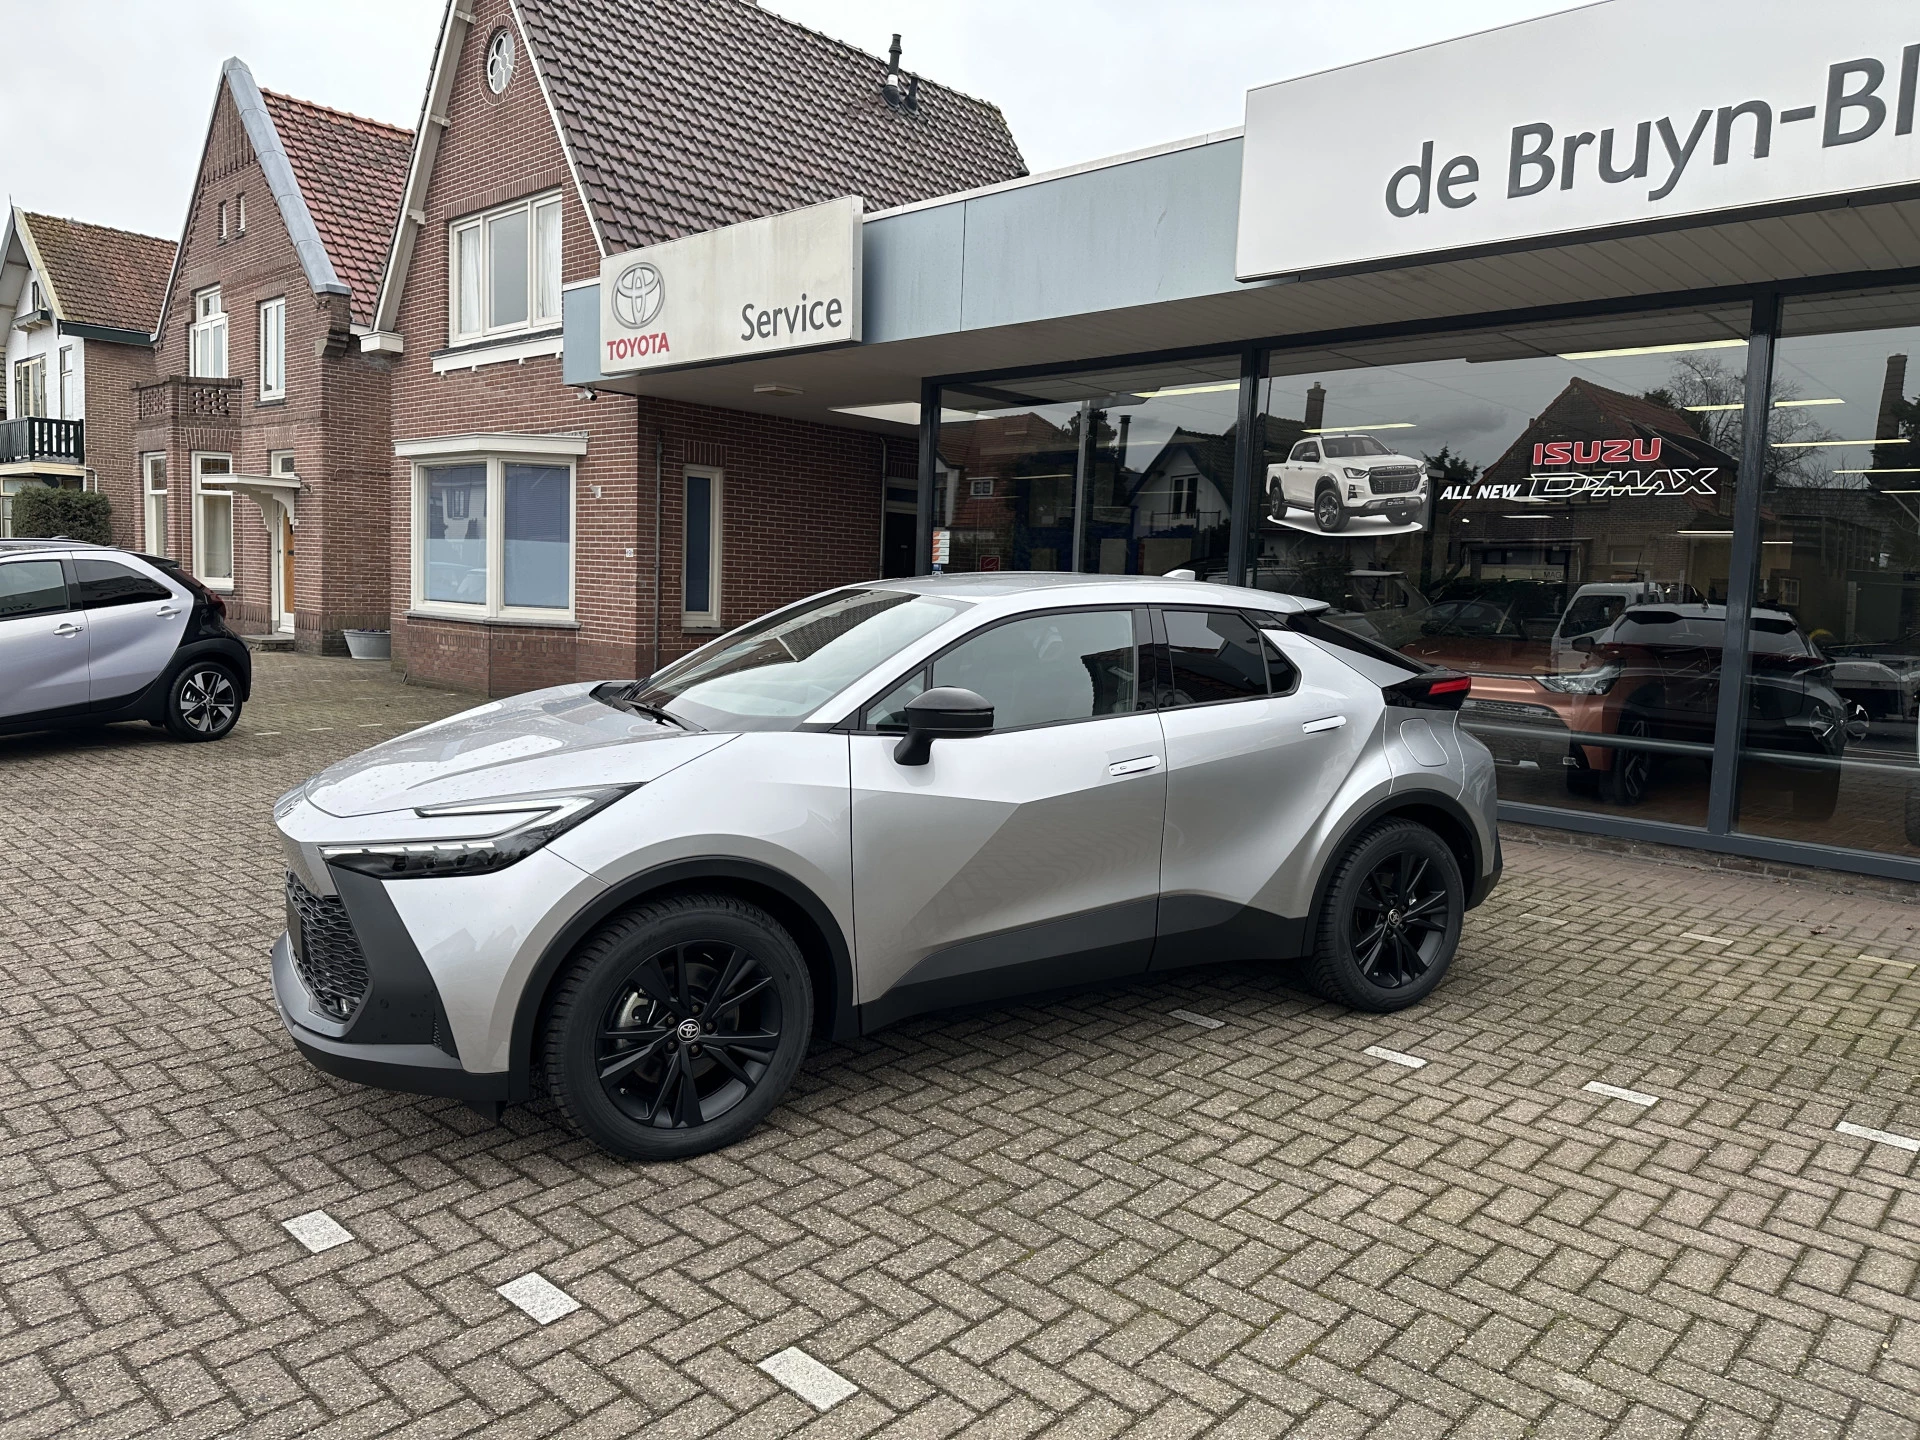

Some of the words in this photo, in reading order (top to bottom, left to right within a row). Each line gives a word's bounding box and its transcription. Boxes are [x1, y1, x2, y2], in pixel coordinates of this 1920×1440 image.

[1385, 141, 1480, 217] de
[740, 293, 842, 341] Service
[606, 332, 670, 360] TOYOTA
[1533, 438, 1661, 465] ISUZU
[1440, 485, 1475, 500] ALL
[1476, 484, 1521, 500] NEW
